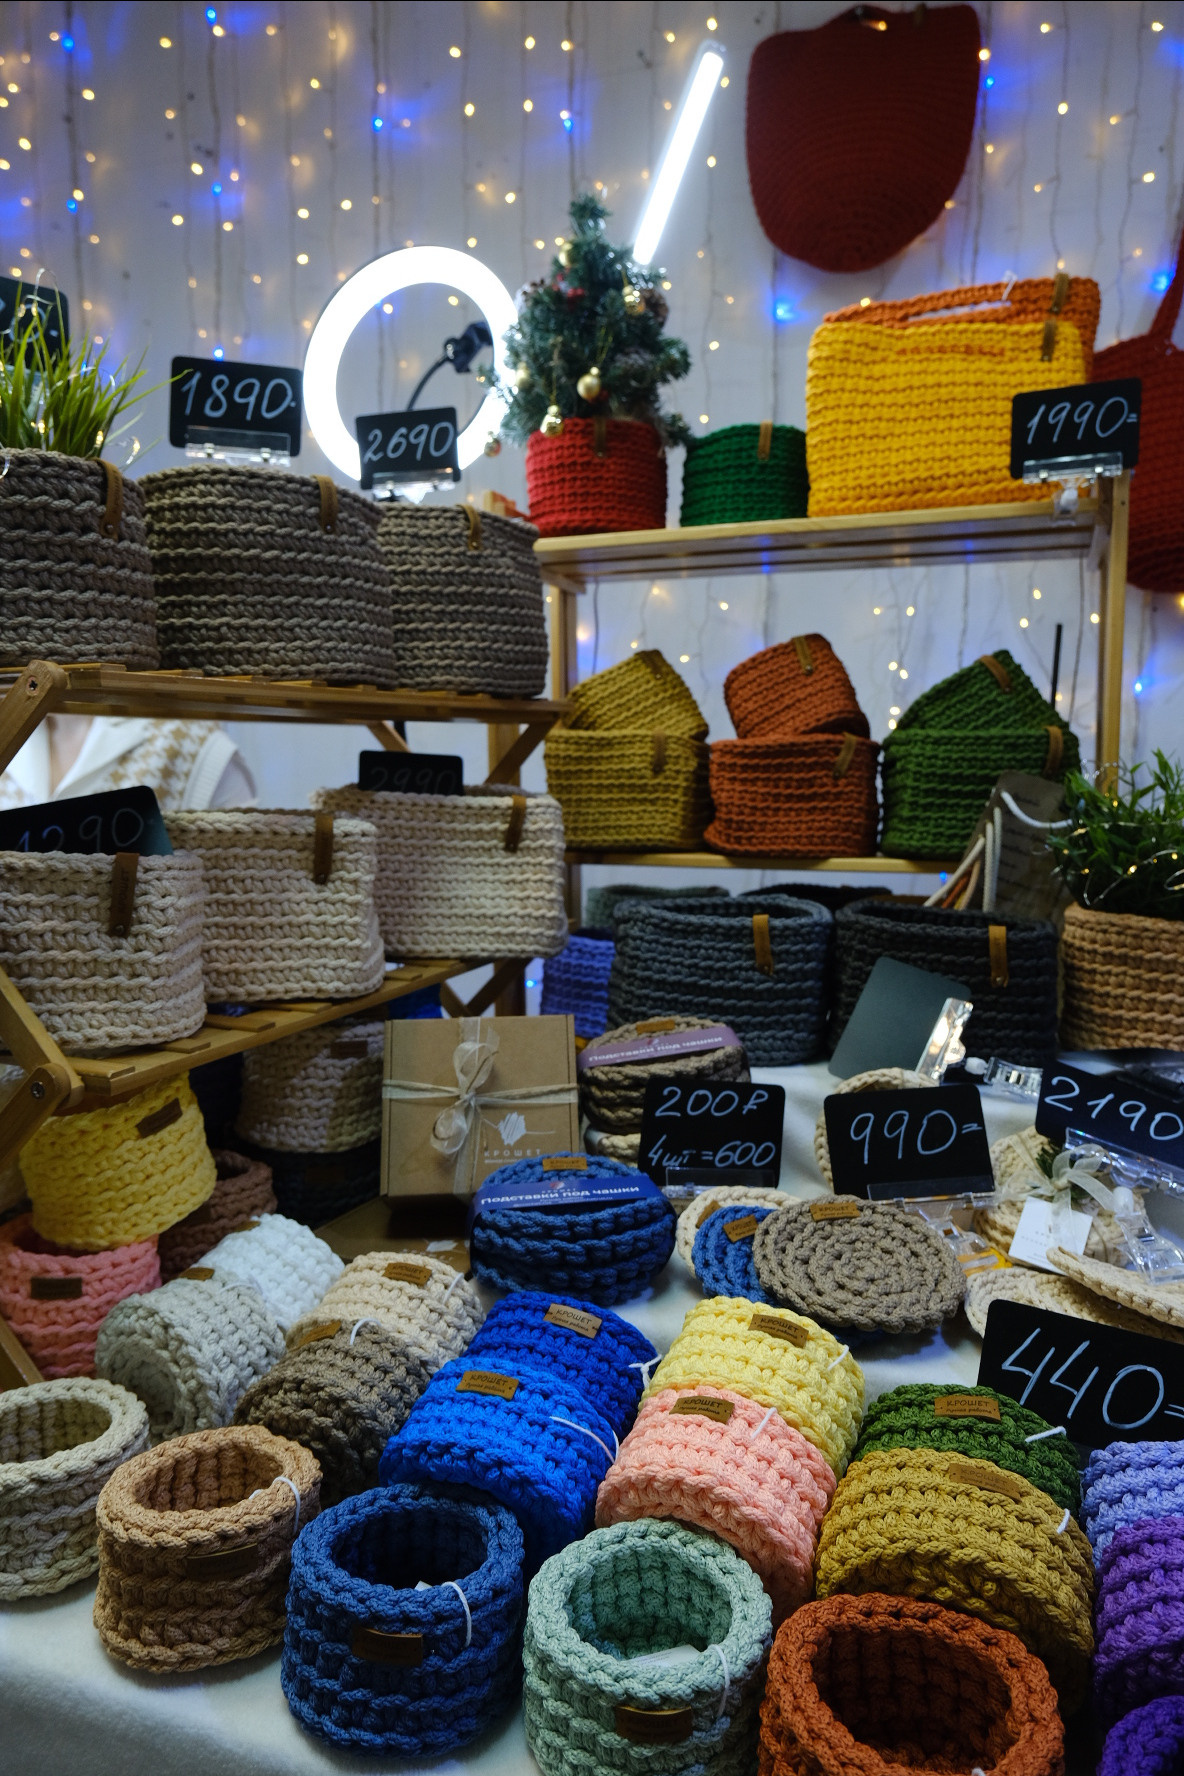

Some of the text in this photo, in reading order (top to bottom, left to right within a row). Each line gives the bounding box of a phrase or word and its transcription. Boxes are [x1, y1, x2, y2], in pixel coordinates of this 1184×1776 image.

[363, 421, 455, 464] 2690
[589, 1045, 655, 1063] Подставки
[682, 1036, 723, 1047] чашки
[1044, 1076, 1184, 1140] 2190
[484, 1148, 541, 1157] КРОШЕТ
[481, 1192, 559, 1205] Подставки
[562, 1190, 591, 1198] под
[592, 1186, 640, 1195] чашки
[556, 1309, 592, 1325] КРОШЕТ
[760, 1317, 799, 1333] КРОШЕТ
[470, 1374, 509, 1386] КРОШЕТ
[683, 1398, 723, 1408] КРОШЕТ
[946, 1399, 990, 1407] КРОШЕТ
